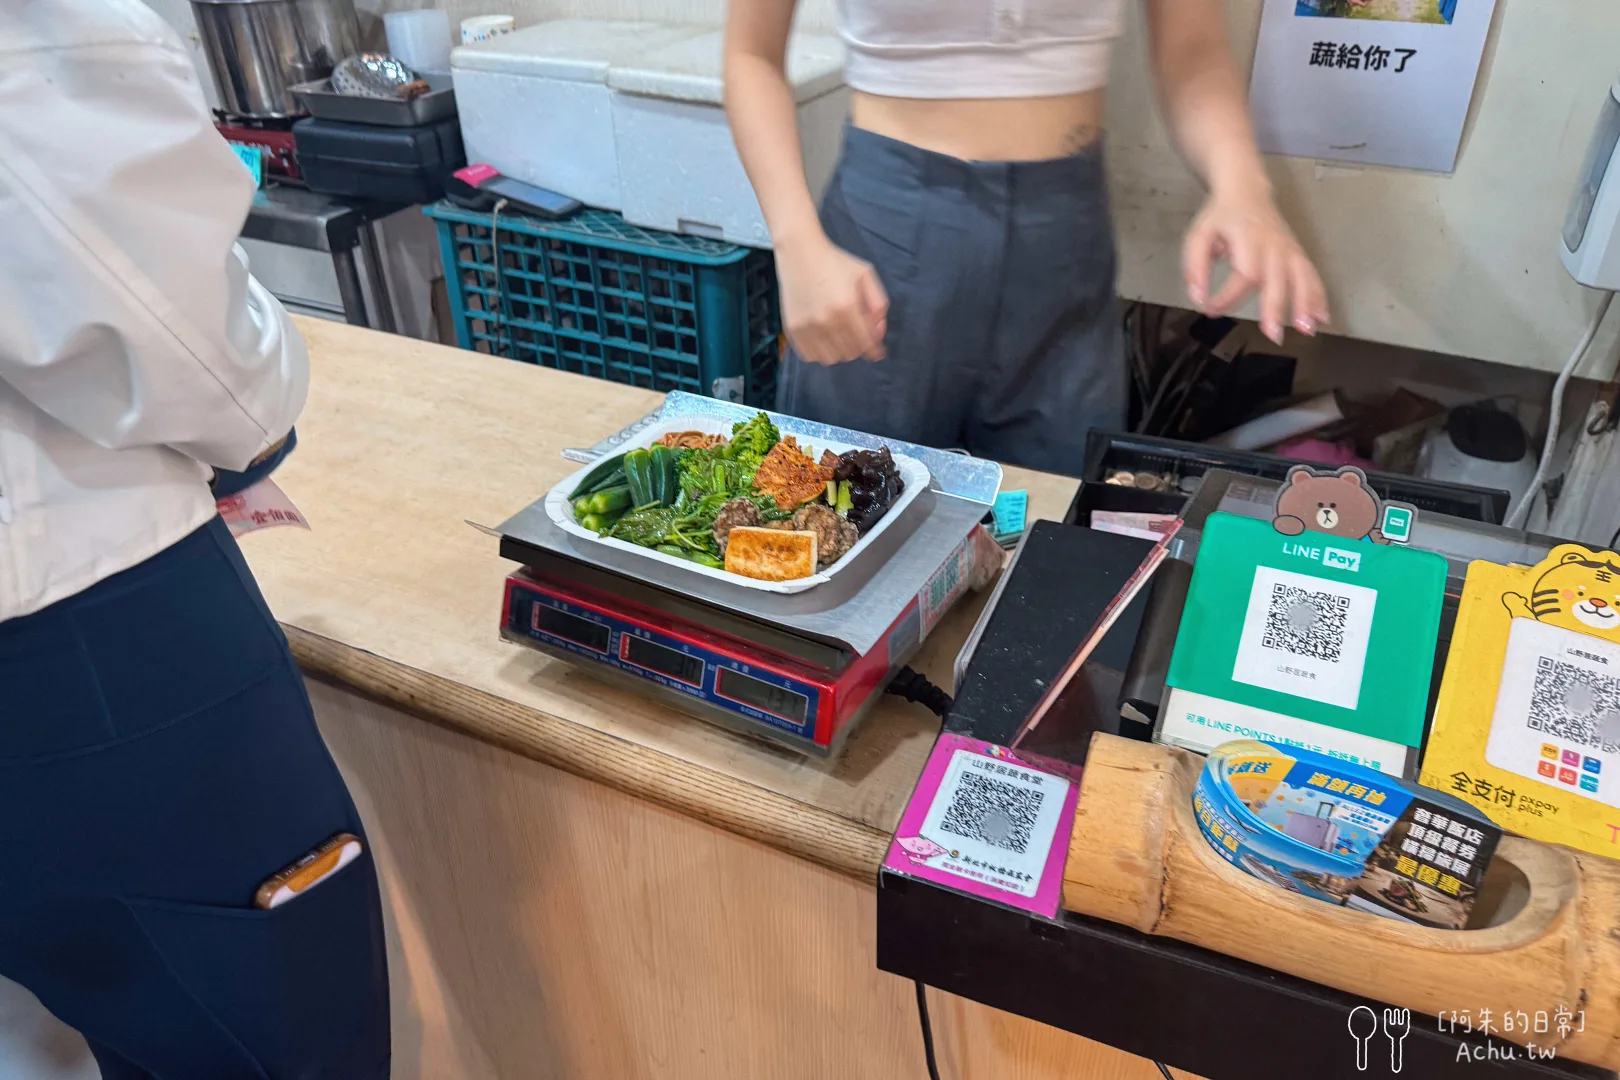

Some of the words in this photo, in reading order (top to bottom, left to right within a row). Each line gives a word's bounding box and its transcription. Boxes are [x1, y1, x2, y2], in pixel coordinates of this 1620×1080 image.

[1309, 41, 1417, 73] 蔬給你了
[1282, 542, 1320, 560] LINE
[1326, 550, 1358, 570] Pay
[1207, 719, 1231, 732] LINE
[1233, 725, 1276, 743] POINTS
[1450, 771, 1516, 808] 全支付
[1519, 795, 1559, 814] pxpay
[1518, 804, 1544, 818] plus
[1395, 855, 1461, 896] 最優惠
